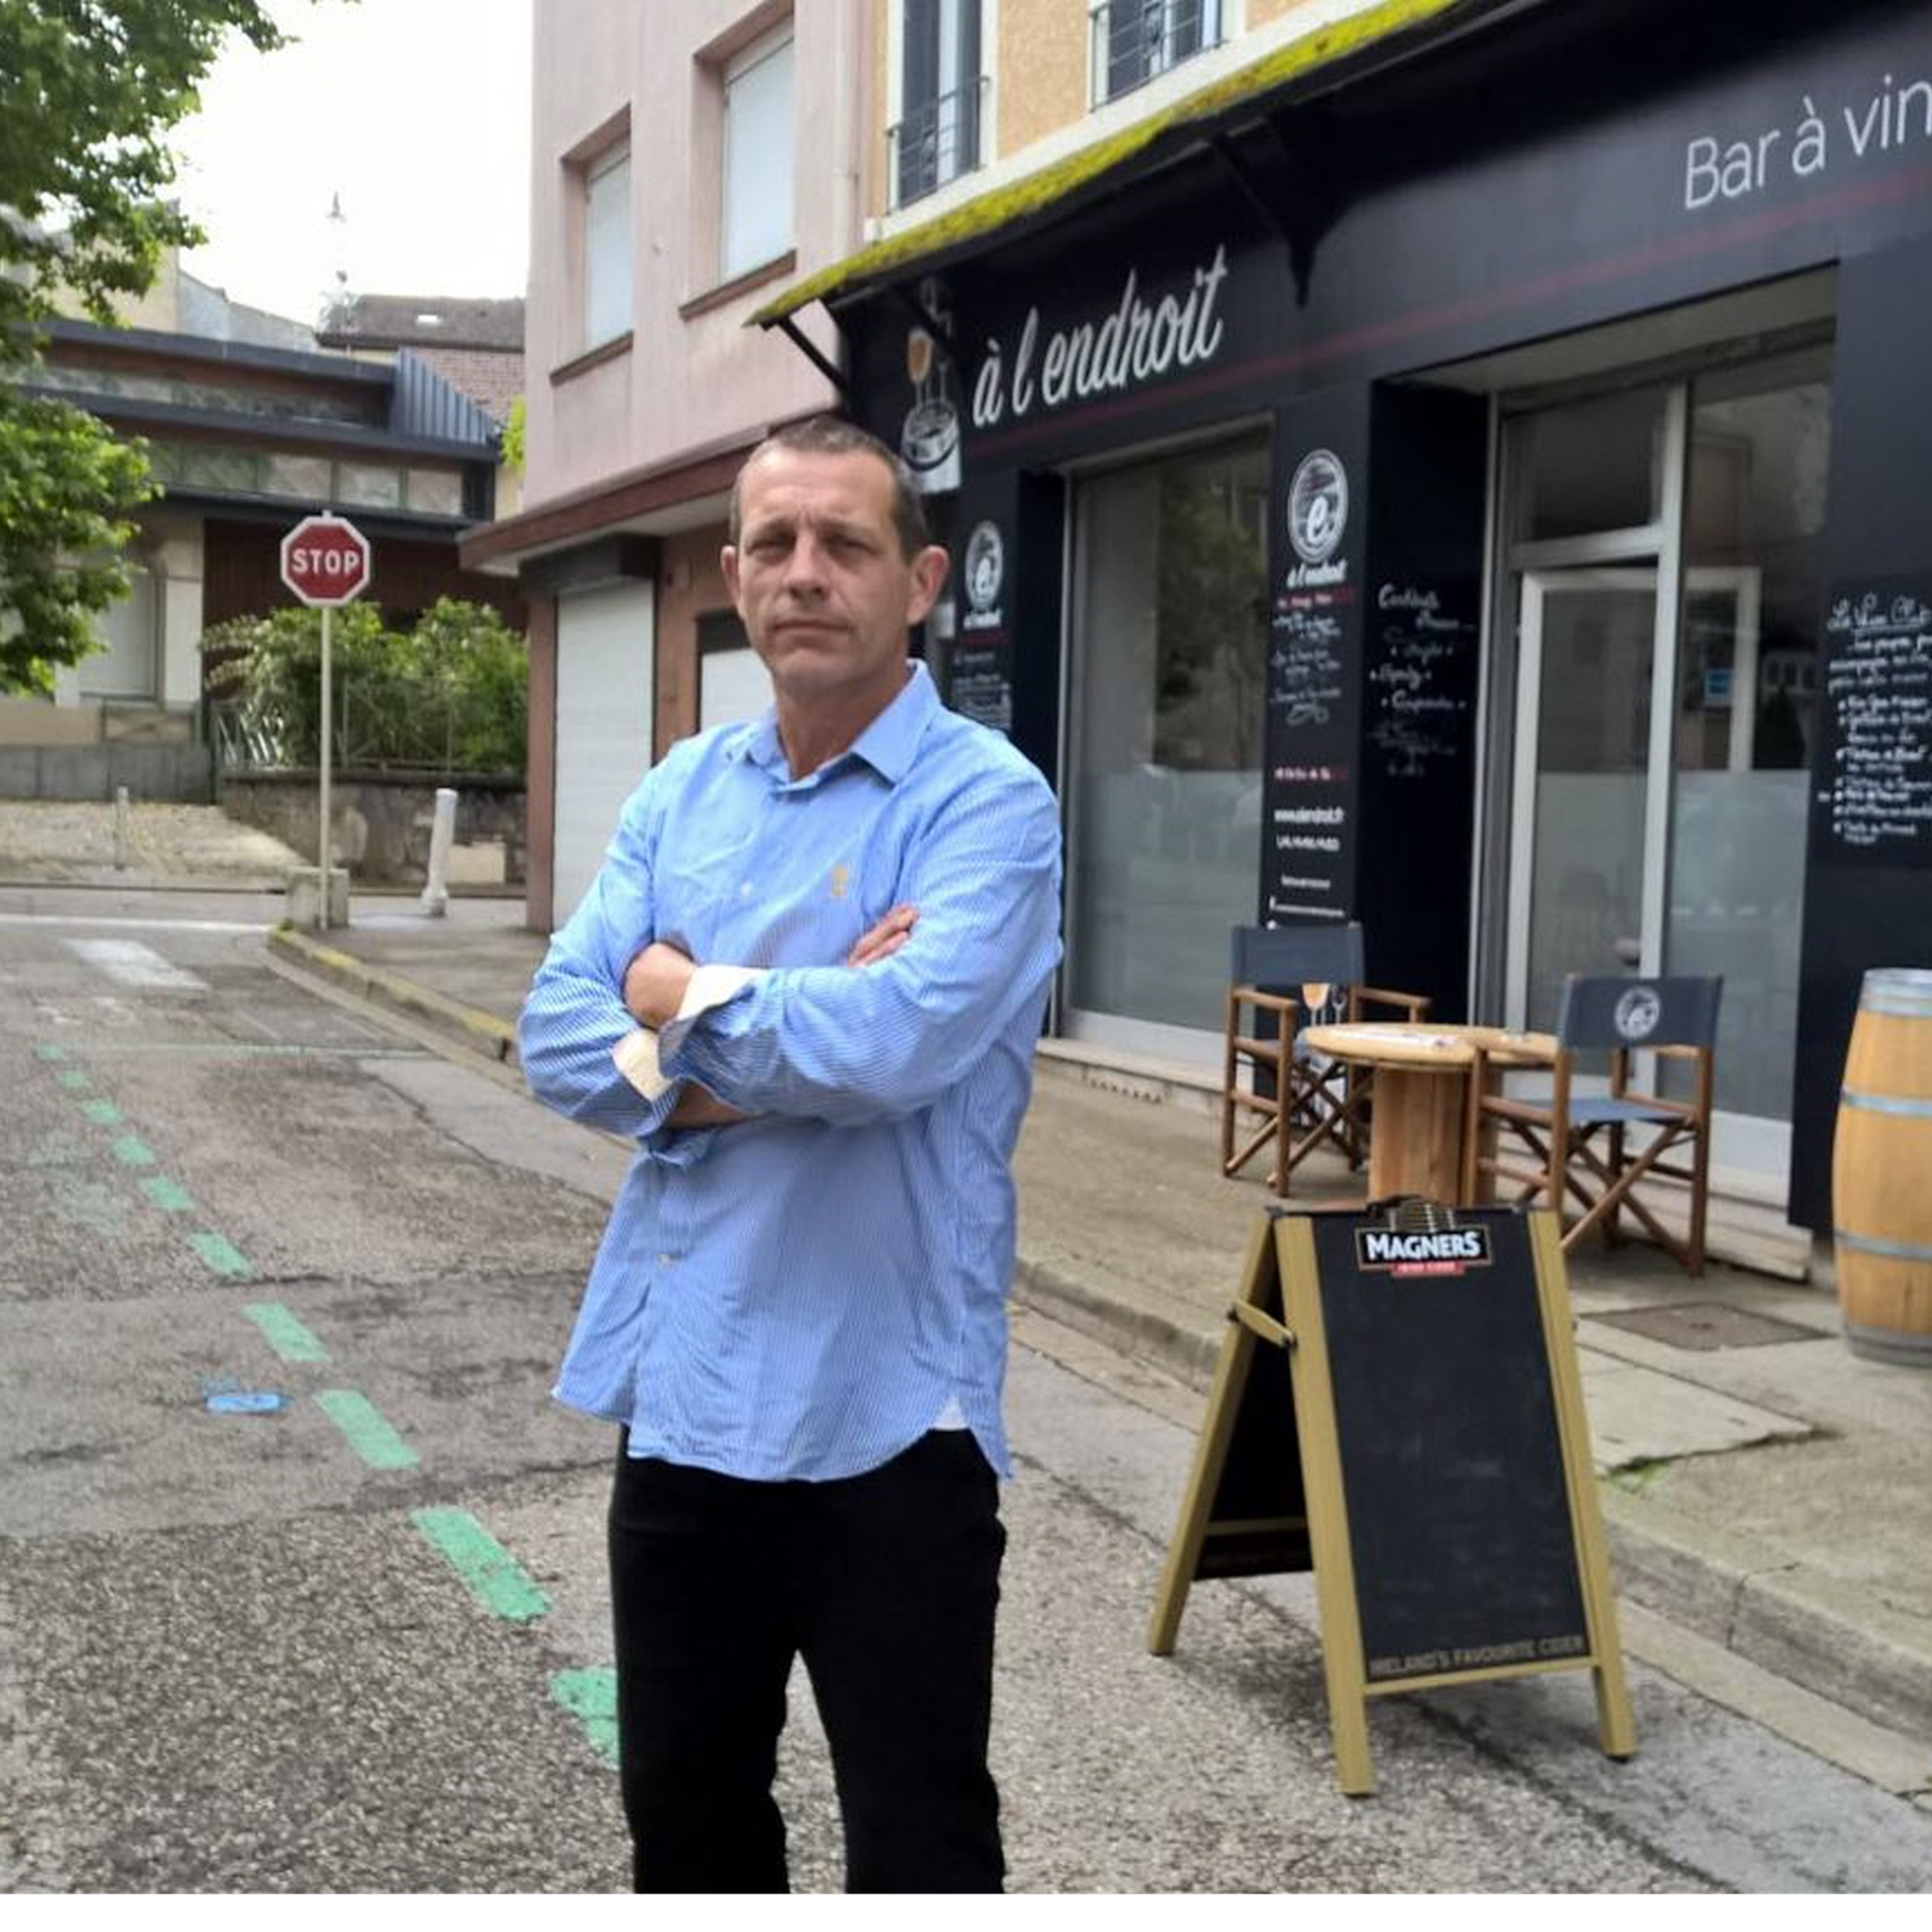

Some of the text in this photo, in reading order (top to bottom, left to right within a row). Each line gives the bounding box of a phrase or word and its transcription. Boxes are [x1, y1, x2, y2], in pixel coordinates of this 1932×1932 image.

[1685, 72, 1932, 209] Bar à vin
[972, 339, 1003, 426] à
[1041, 243, 1227, 406] endroit
[292, 548, 361, 575] STOP
[1365, 1231, 1481, 1261] MAGNERS
